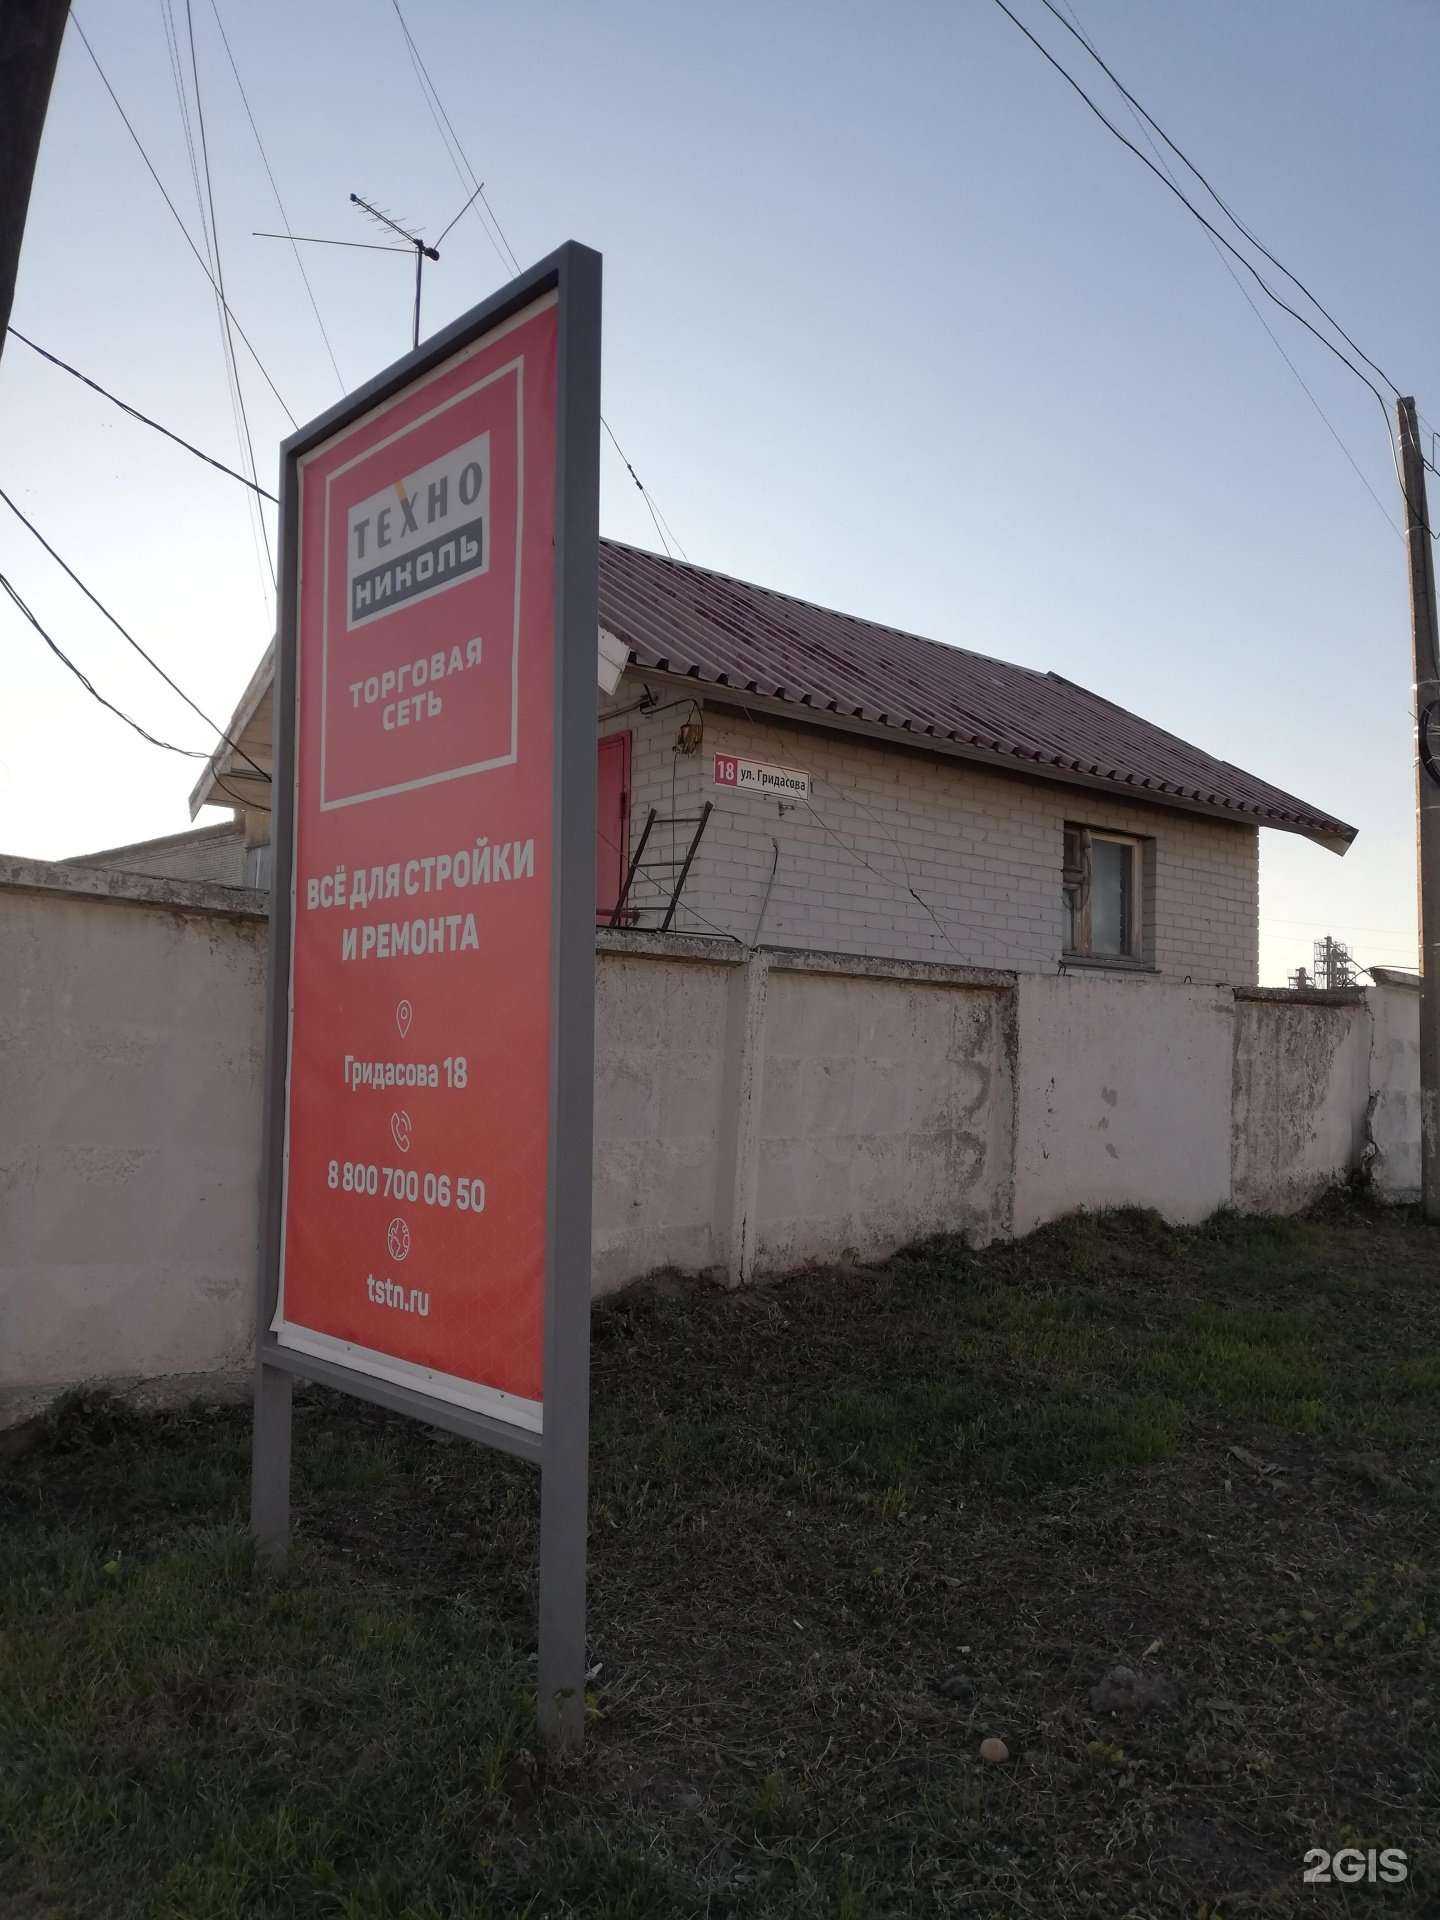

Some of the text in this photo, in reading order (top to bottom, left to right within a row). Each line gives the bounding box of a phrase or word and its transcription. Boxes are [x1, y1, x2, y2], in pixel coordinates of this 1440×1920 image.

[353, 461, 483, 559] ТЕХНО
[355, 533, 479, 609] НИКОЛЬ
[350, 637, 483, 708] ТОРГОВАЯ
[382, 691, 443, 730] СЕТЬ
[717, 760, 806, 791] 18 ул. Гридасова
[307, 836, 535, 910] ВСЁ ДЛЯ СТРОЙКИ
[342, 913, 480, 961] И РЕМОНТА
[344, 1055, 468, 1092] Гридасова 18
[328, 1160, 485, 1213] 8 800 700 06 50
[367, 1274, 429, 1316] tstn.ru
